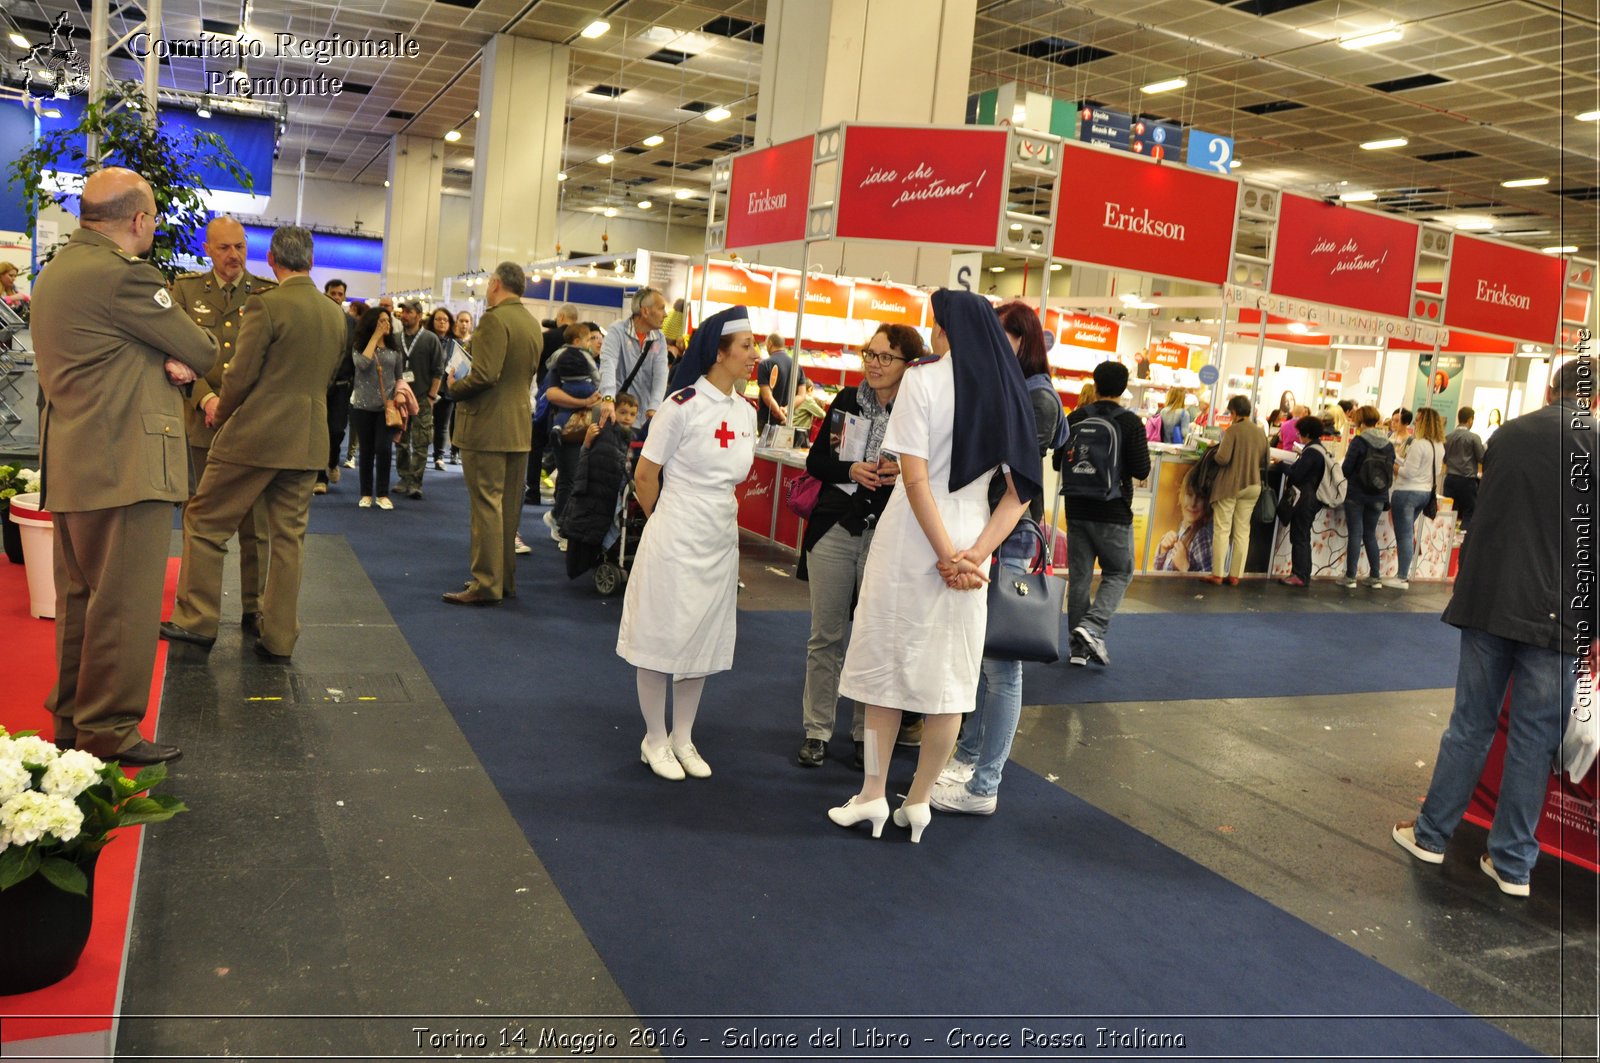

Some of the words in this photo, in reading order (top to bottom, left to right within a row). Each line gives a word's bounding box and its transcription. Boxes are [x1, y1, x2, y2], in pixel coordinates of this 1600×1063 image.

[1108, 127, 1117, 136] Bar
[1208, 138, 1230, 174] 3
[860, 166, 898, 188] idee
[902, 162, 935, 184] che
[747, 191, 787, 215] Erickson
[1103, 201, 1185, 241] Erickson
[1310, 236, 1337, 256] idee
[1337, 237, 1359, 255] che
[1475, 279, 1531, 310] Erickson
[871, 299, 906, 313] Didattica
[1074, 319, 1111, 334] Metodologie
[1074, 330, 1107, 343] didattiche
